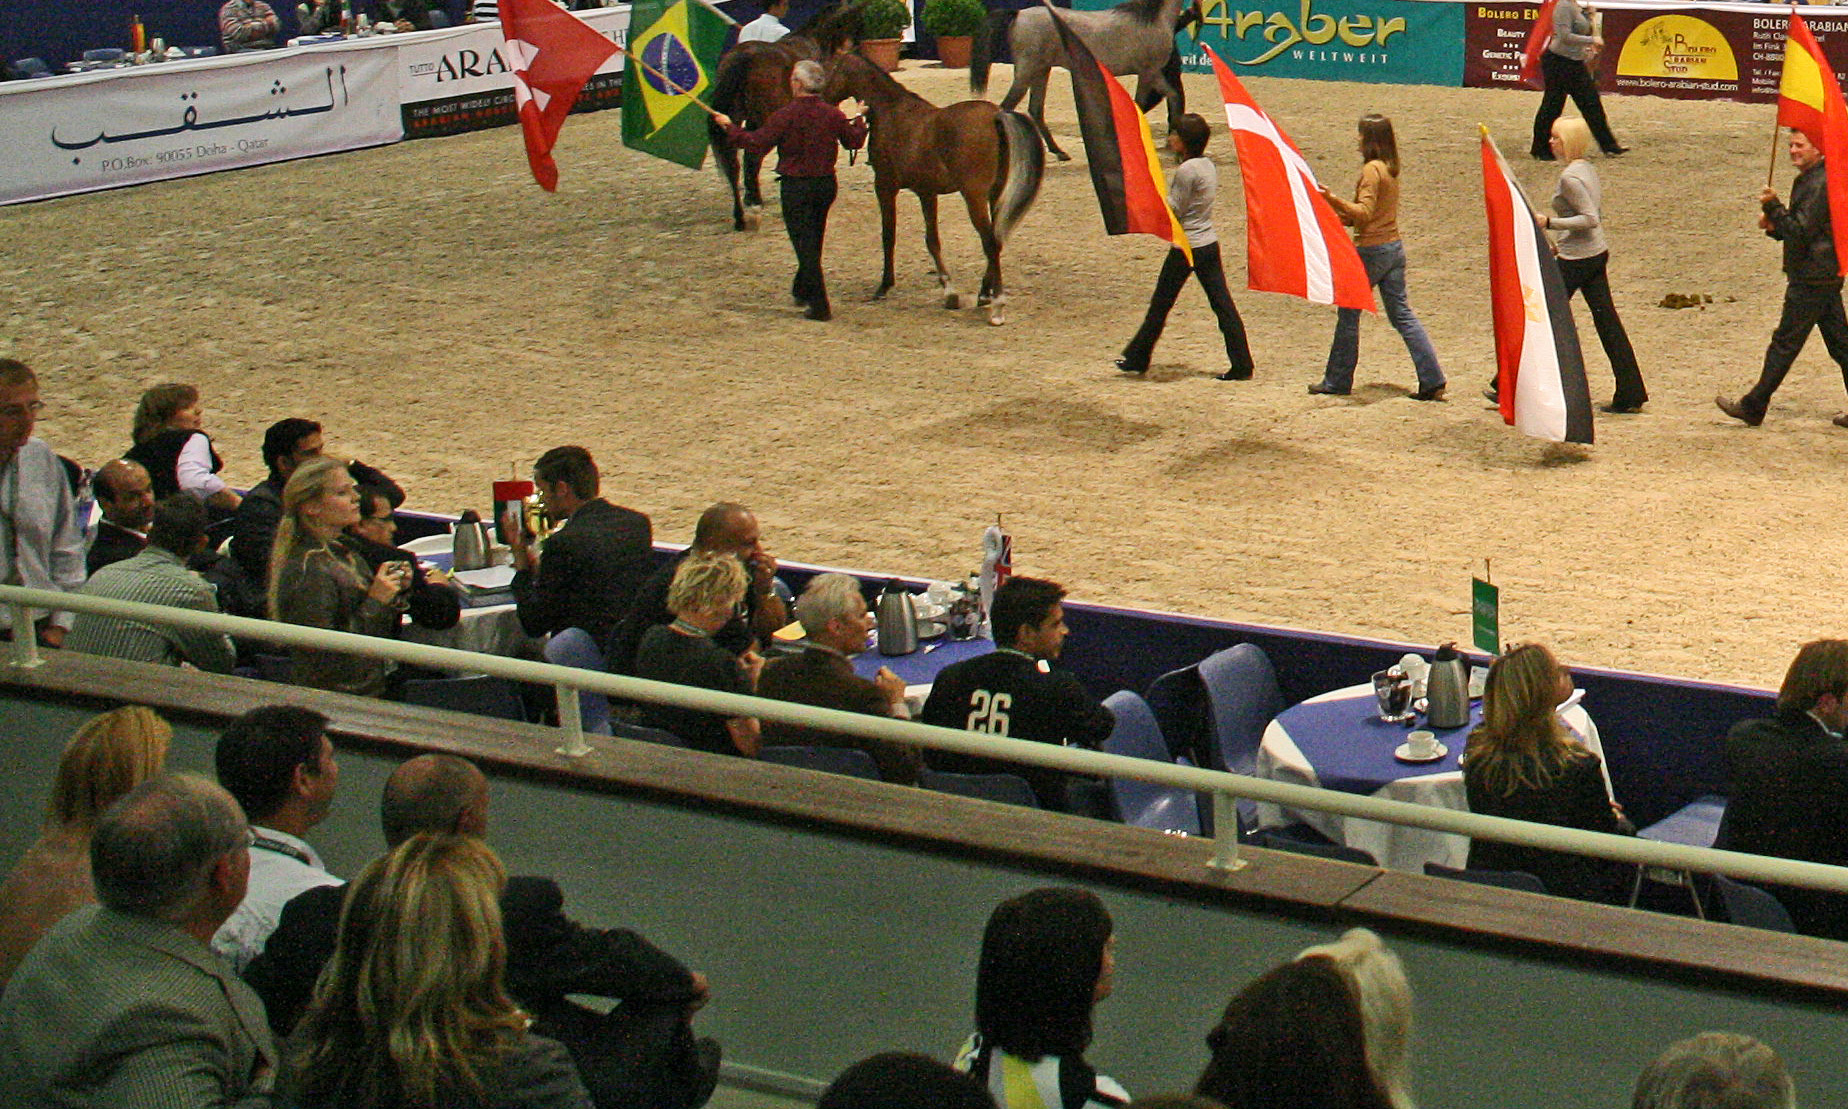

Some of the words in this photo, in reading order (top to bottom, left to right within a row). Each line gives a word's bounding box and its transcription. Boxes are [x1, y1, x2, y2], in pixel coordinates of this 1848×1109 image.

[1753, 18, 1791, 30] BOLER
[436, 46, 513, 83] ARA
[1292, 50, 1389, 64] WELTWEIT
[51, 64, 349, 166] الشقب
[156, 147, 193, 163] 90055
[196, 142, 227, 158] Doha
[238, 138, 269, 153] Qatar
[966, 688, 1012, 737] 26
